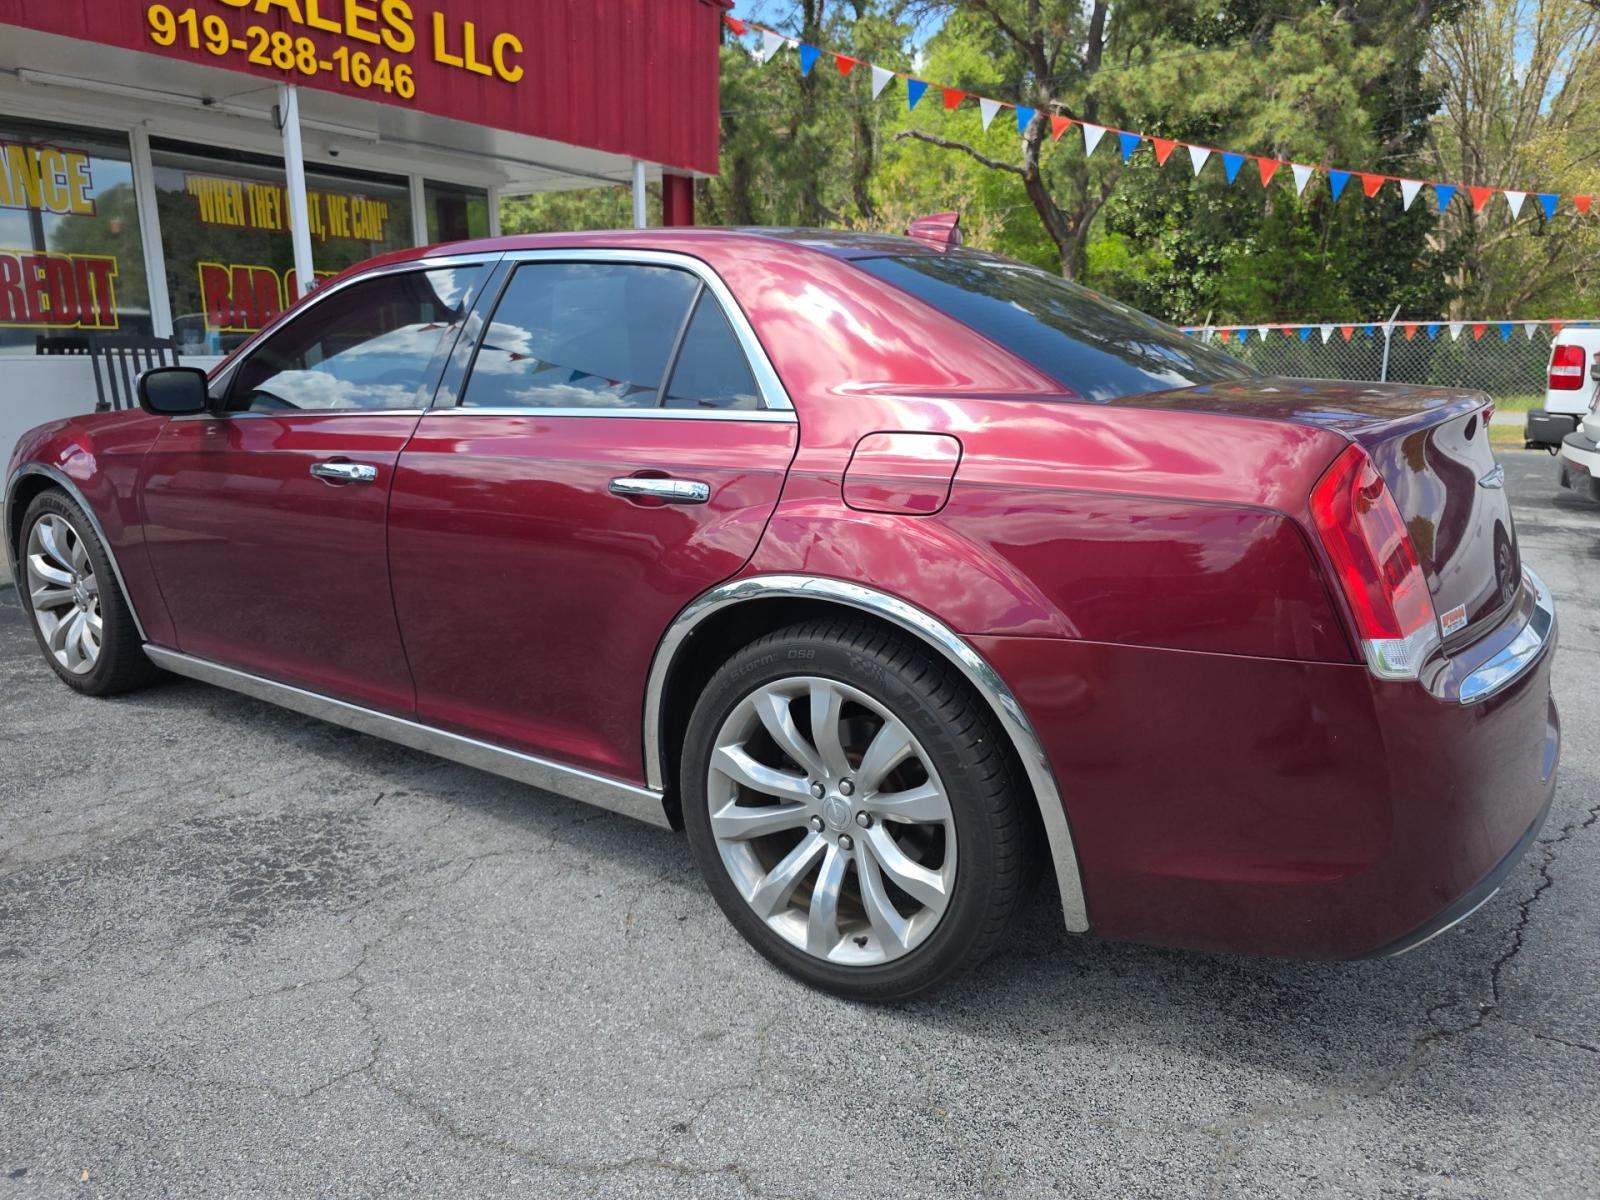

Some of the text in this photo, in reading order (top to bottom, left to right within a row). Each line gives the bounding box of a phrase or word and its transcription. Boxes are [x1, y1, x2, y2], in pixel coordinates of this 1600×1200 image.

[147, 4, 416, 99] 919-288-1646
[219, 0, 524, 83] LES LLC
[187, 174, 246, 226] "WHEN
[247, 182, 282, 230] THEY
[327, 193, 350, 238] WE
[198, 262, 284, 332] BAD
